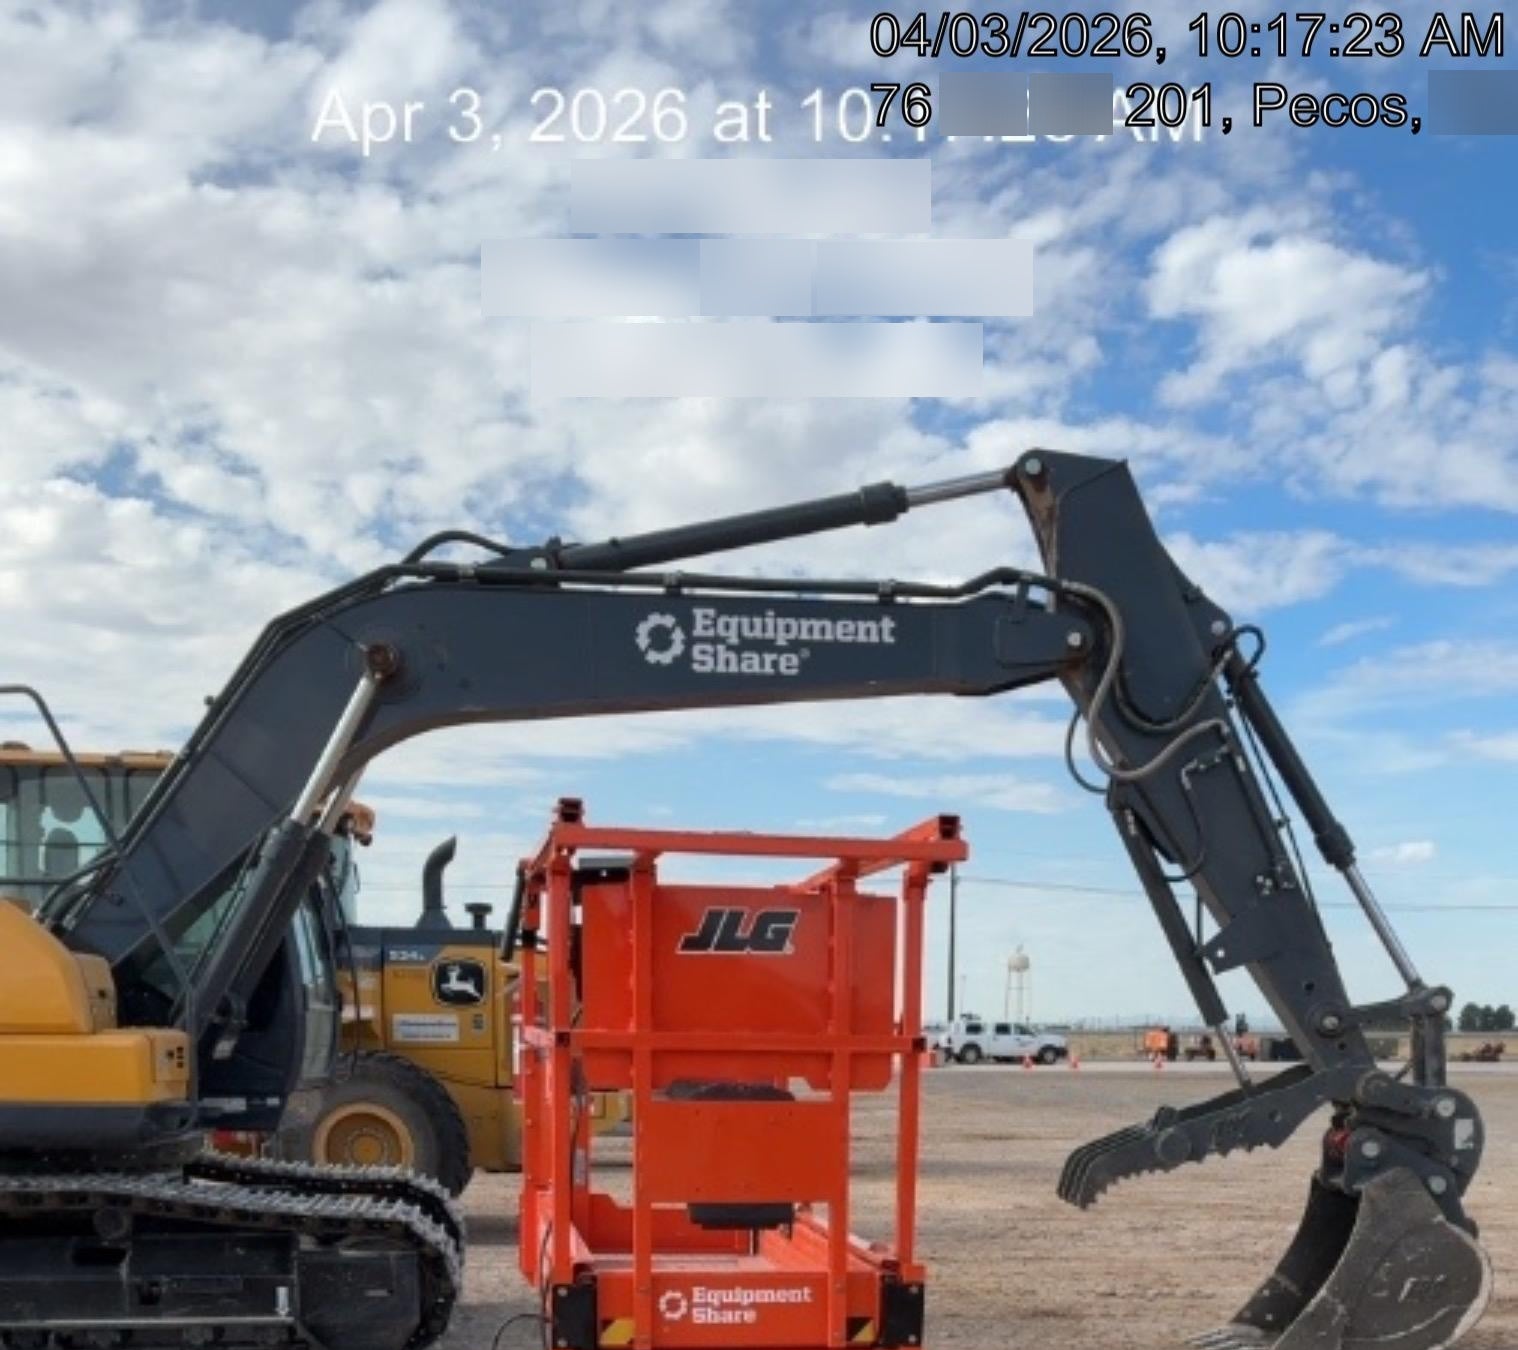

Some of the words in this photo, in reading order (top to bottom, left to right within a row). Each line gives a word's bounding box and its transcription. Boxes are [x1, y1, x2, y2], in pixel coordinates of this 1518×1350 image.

[691, 607, 896, 647] Equipment
[676, 905, 801, 954] JLG
[691, 1286, 814, 1306] Equipment
[691, 1307, 758, 1325] Share
